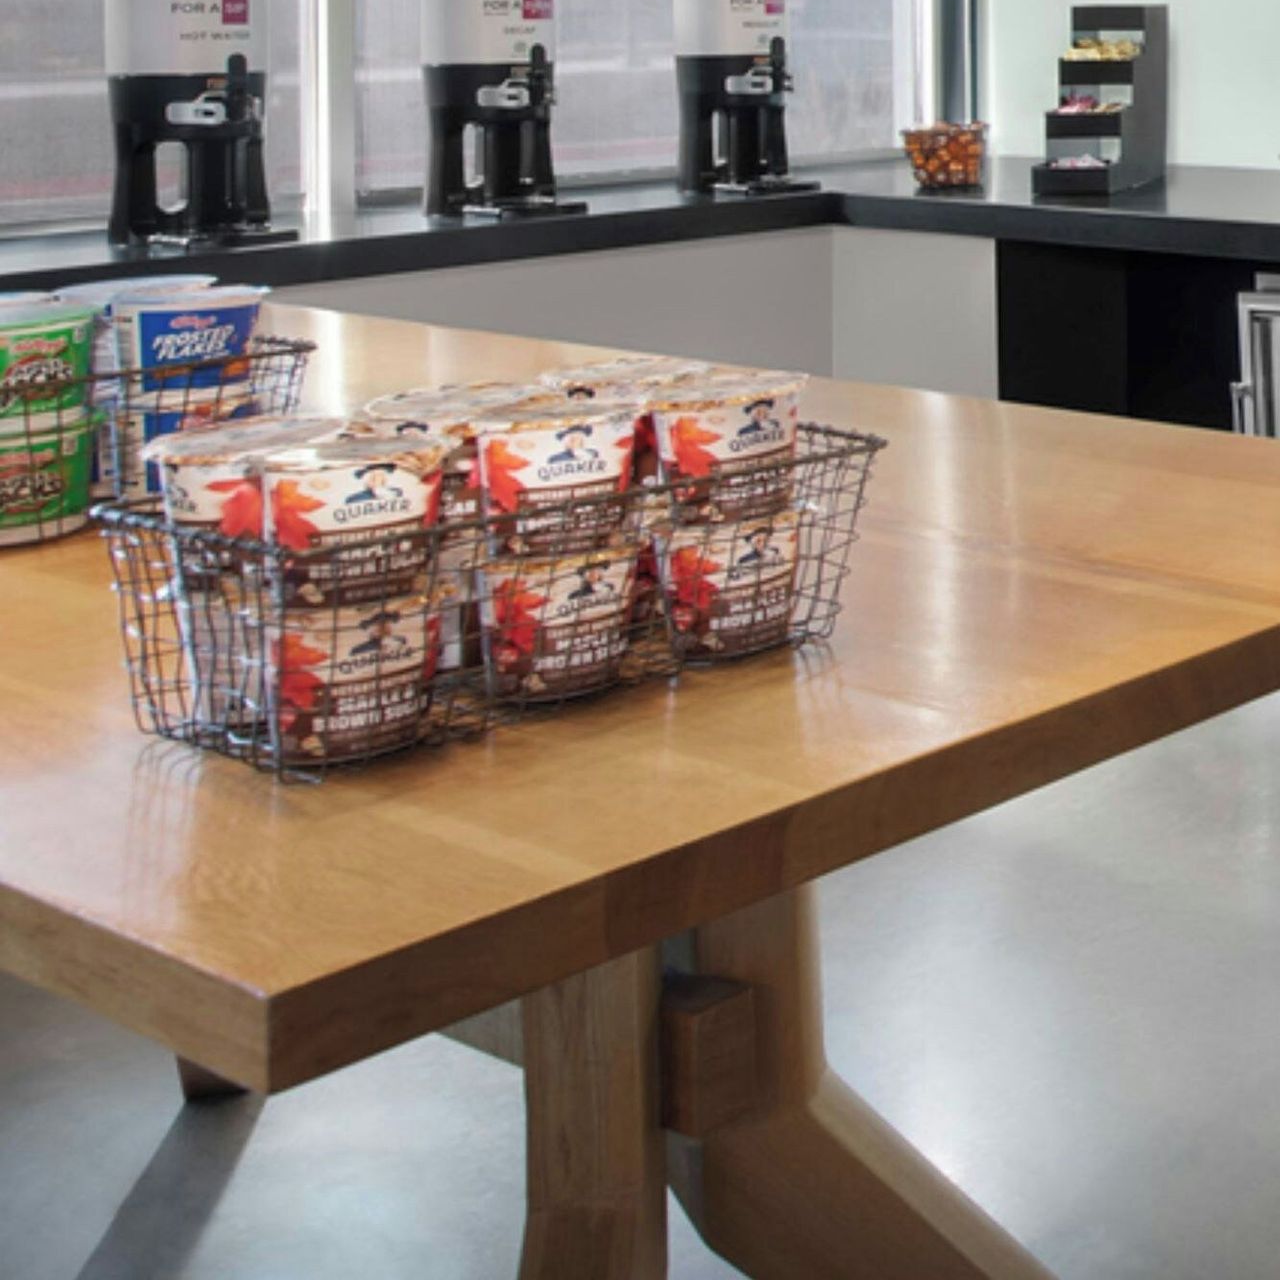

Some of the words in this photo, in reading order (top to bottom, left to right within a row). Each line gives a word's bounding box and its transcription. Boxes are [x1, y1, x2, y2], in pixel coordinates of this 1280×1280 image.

[170, 2, 205, 14] FOR
[210, 2, 220, 14] A
[482, 0, 510, 11] FOR
[513, 0, 522, 9] A
[179, 30, 207, 41] HOT
[153, 324, 235, 350] FROSTED
[157, 341, 227, 361] FLAKES
[728, 426, 784, 452] QUAKER
[538, 460, 607, 481] QUAKER
[333, 499, 411, 522] QUAKER
